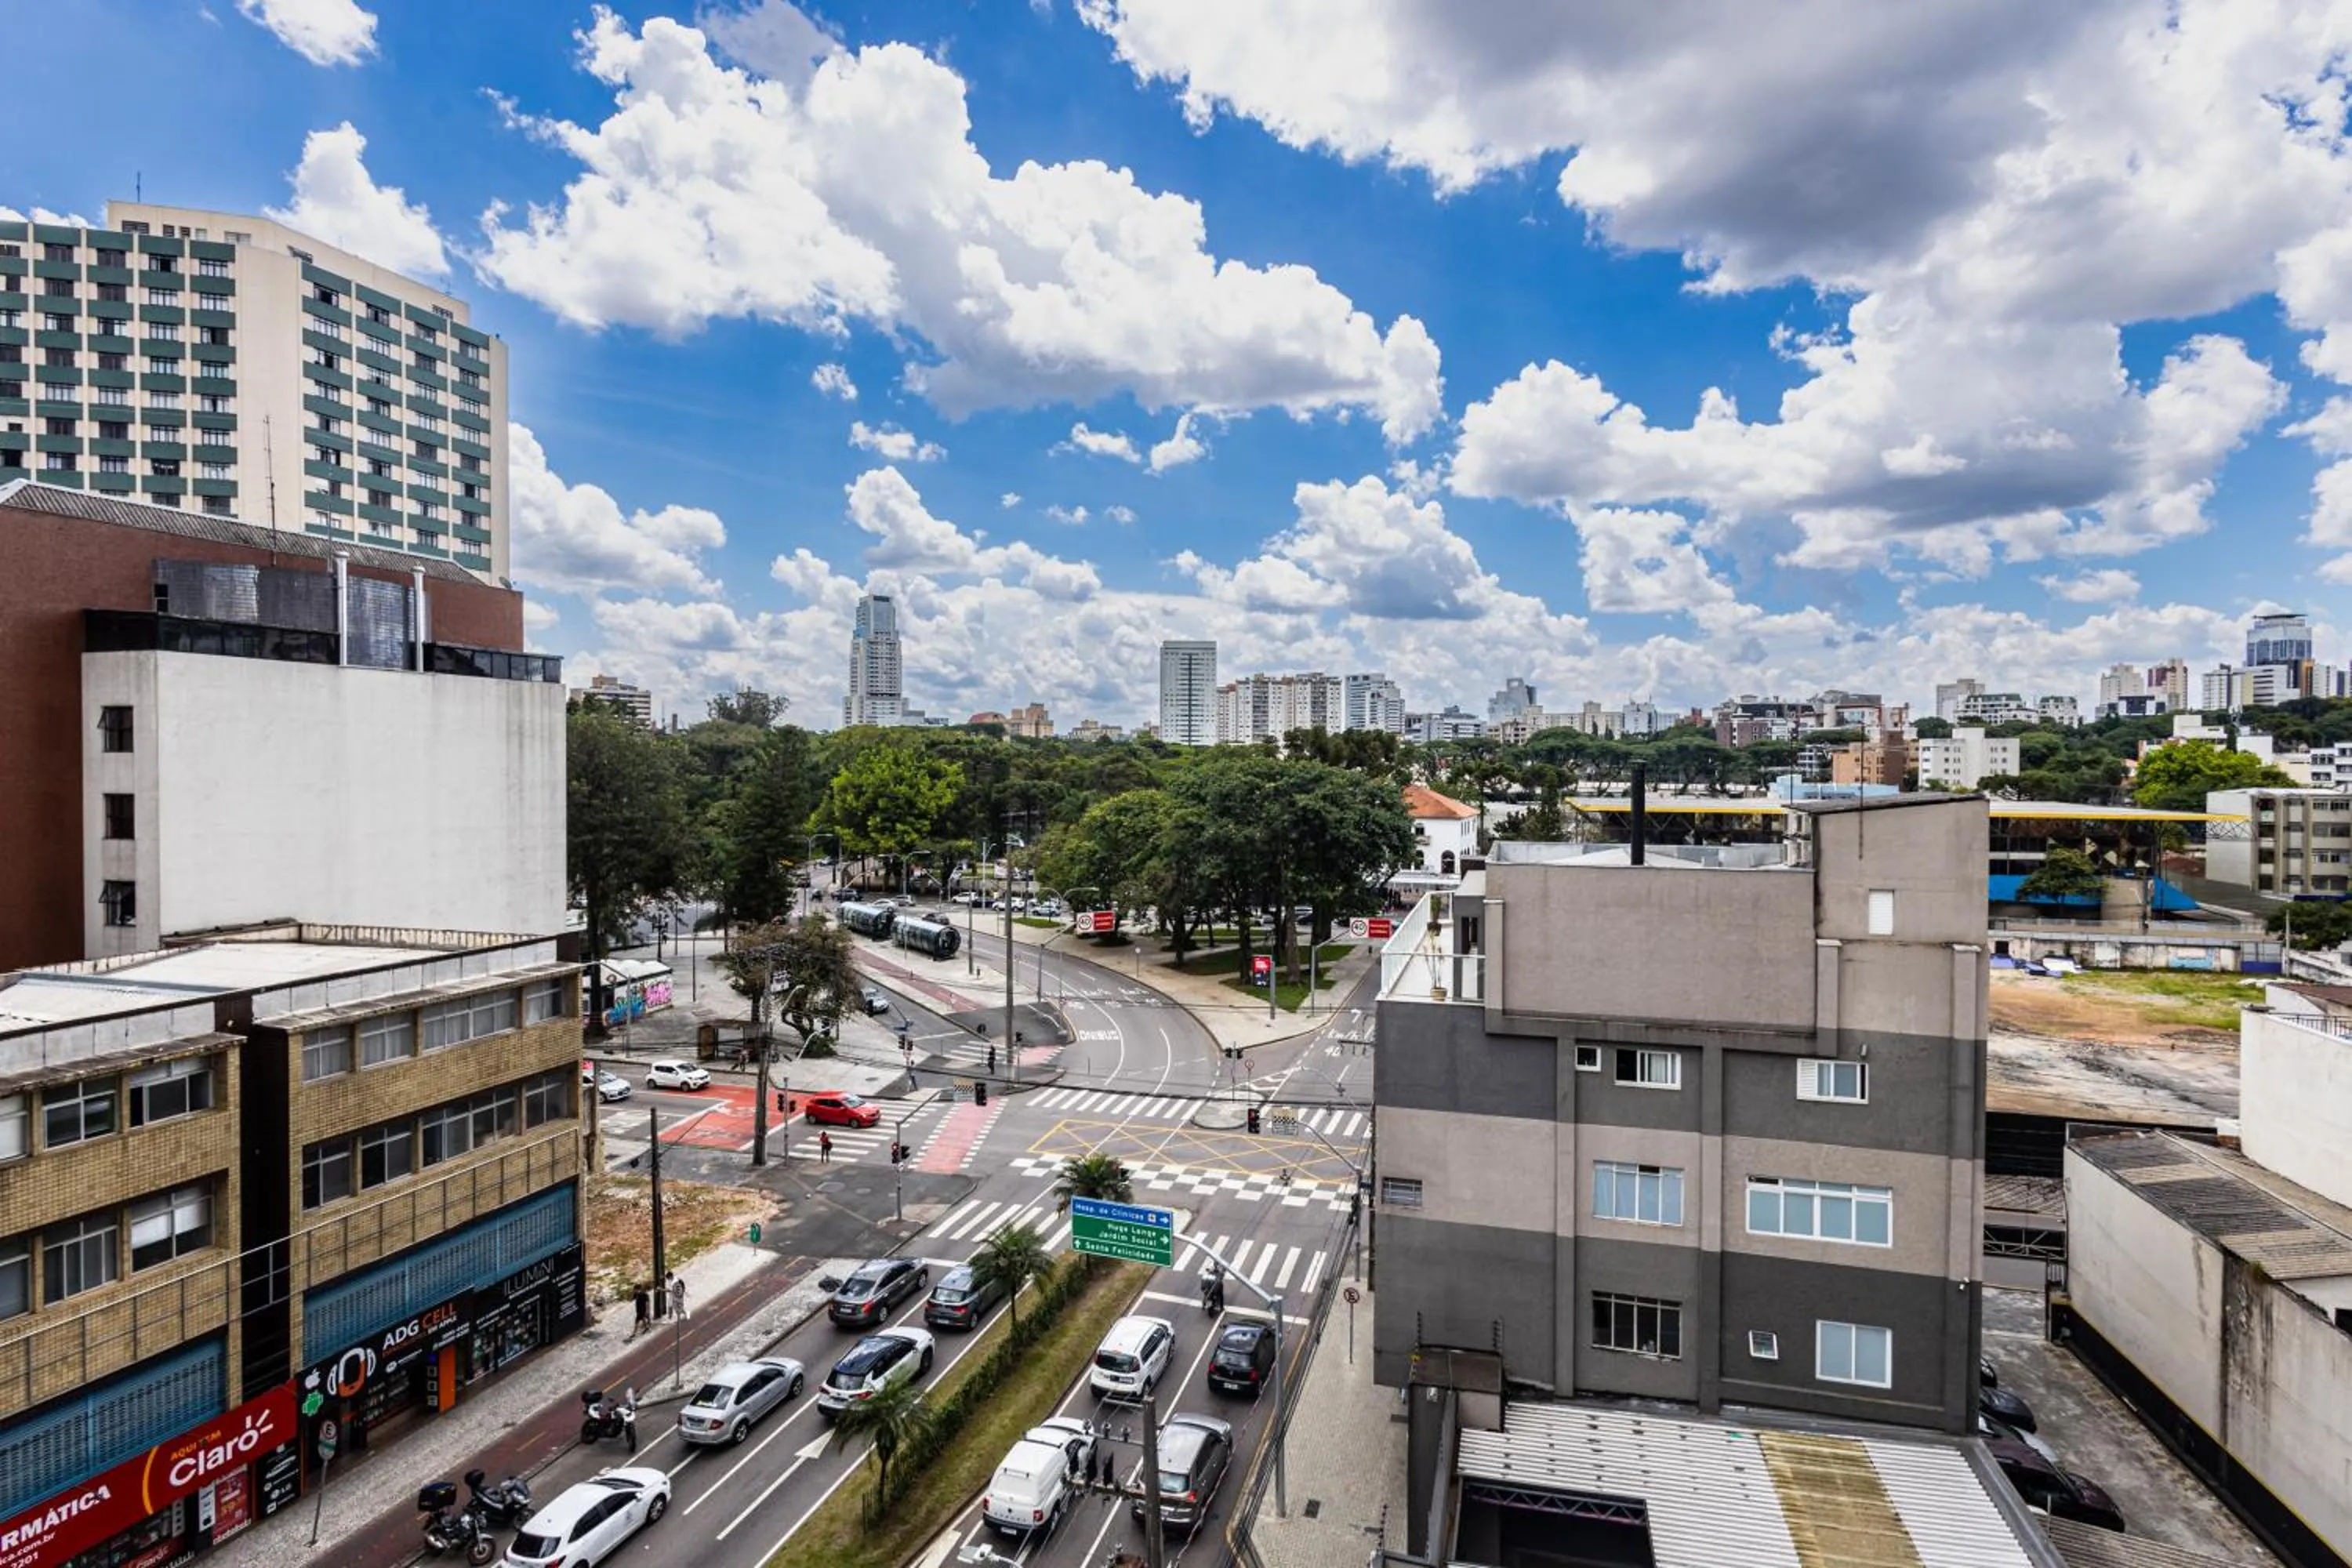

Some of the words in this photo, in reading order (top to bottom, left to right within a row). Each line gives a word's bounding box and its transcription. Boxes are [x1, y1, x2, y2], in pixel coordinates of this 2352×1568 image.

[1099, 1231, 1127, 1241] Jardim
[1131, 1235, 1156, 1246] Social
[1131, 1227, 1156, 1237] Lange
[1085, 1242, 1109, 1253] Santa
[1112, 1246, 1155, 1260] Felicidade
[383, 1320, 419, 1350] ADG
[422, 1302, 456, 1329] CELL
[169, 1421, 263, 1486] Claro
[170, 1442, 197, 1461] AQUI
